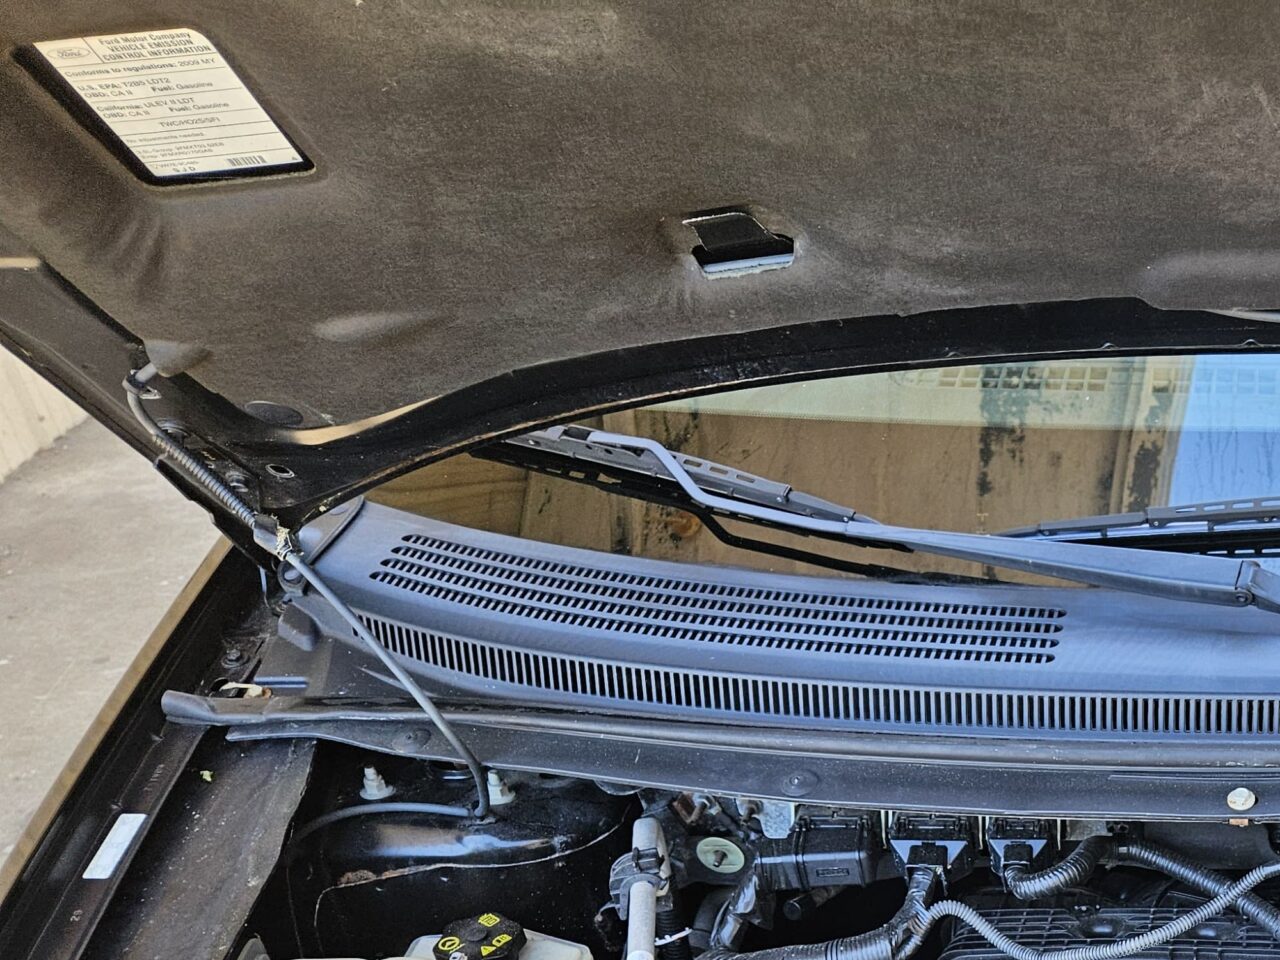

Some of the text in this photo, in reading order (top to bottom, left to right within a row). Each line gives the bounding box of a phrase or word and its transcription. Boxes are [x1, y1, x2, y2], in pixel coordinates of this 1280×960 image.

[119, 34, 148, 42] Motor
[147, 30, 192, 41] Company
[106, 39, 194, 51] VEHICLE EMISSION
[101, 45, 212, 60] CONTROL INFORMATION
[63, 68, 110, 77] Conforms
[120, 61, 178, 72] regulations:
[149, 81, 214, 92] Fuel: Gasoline
